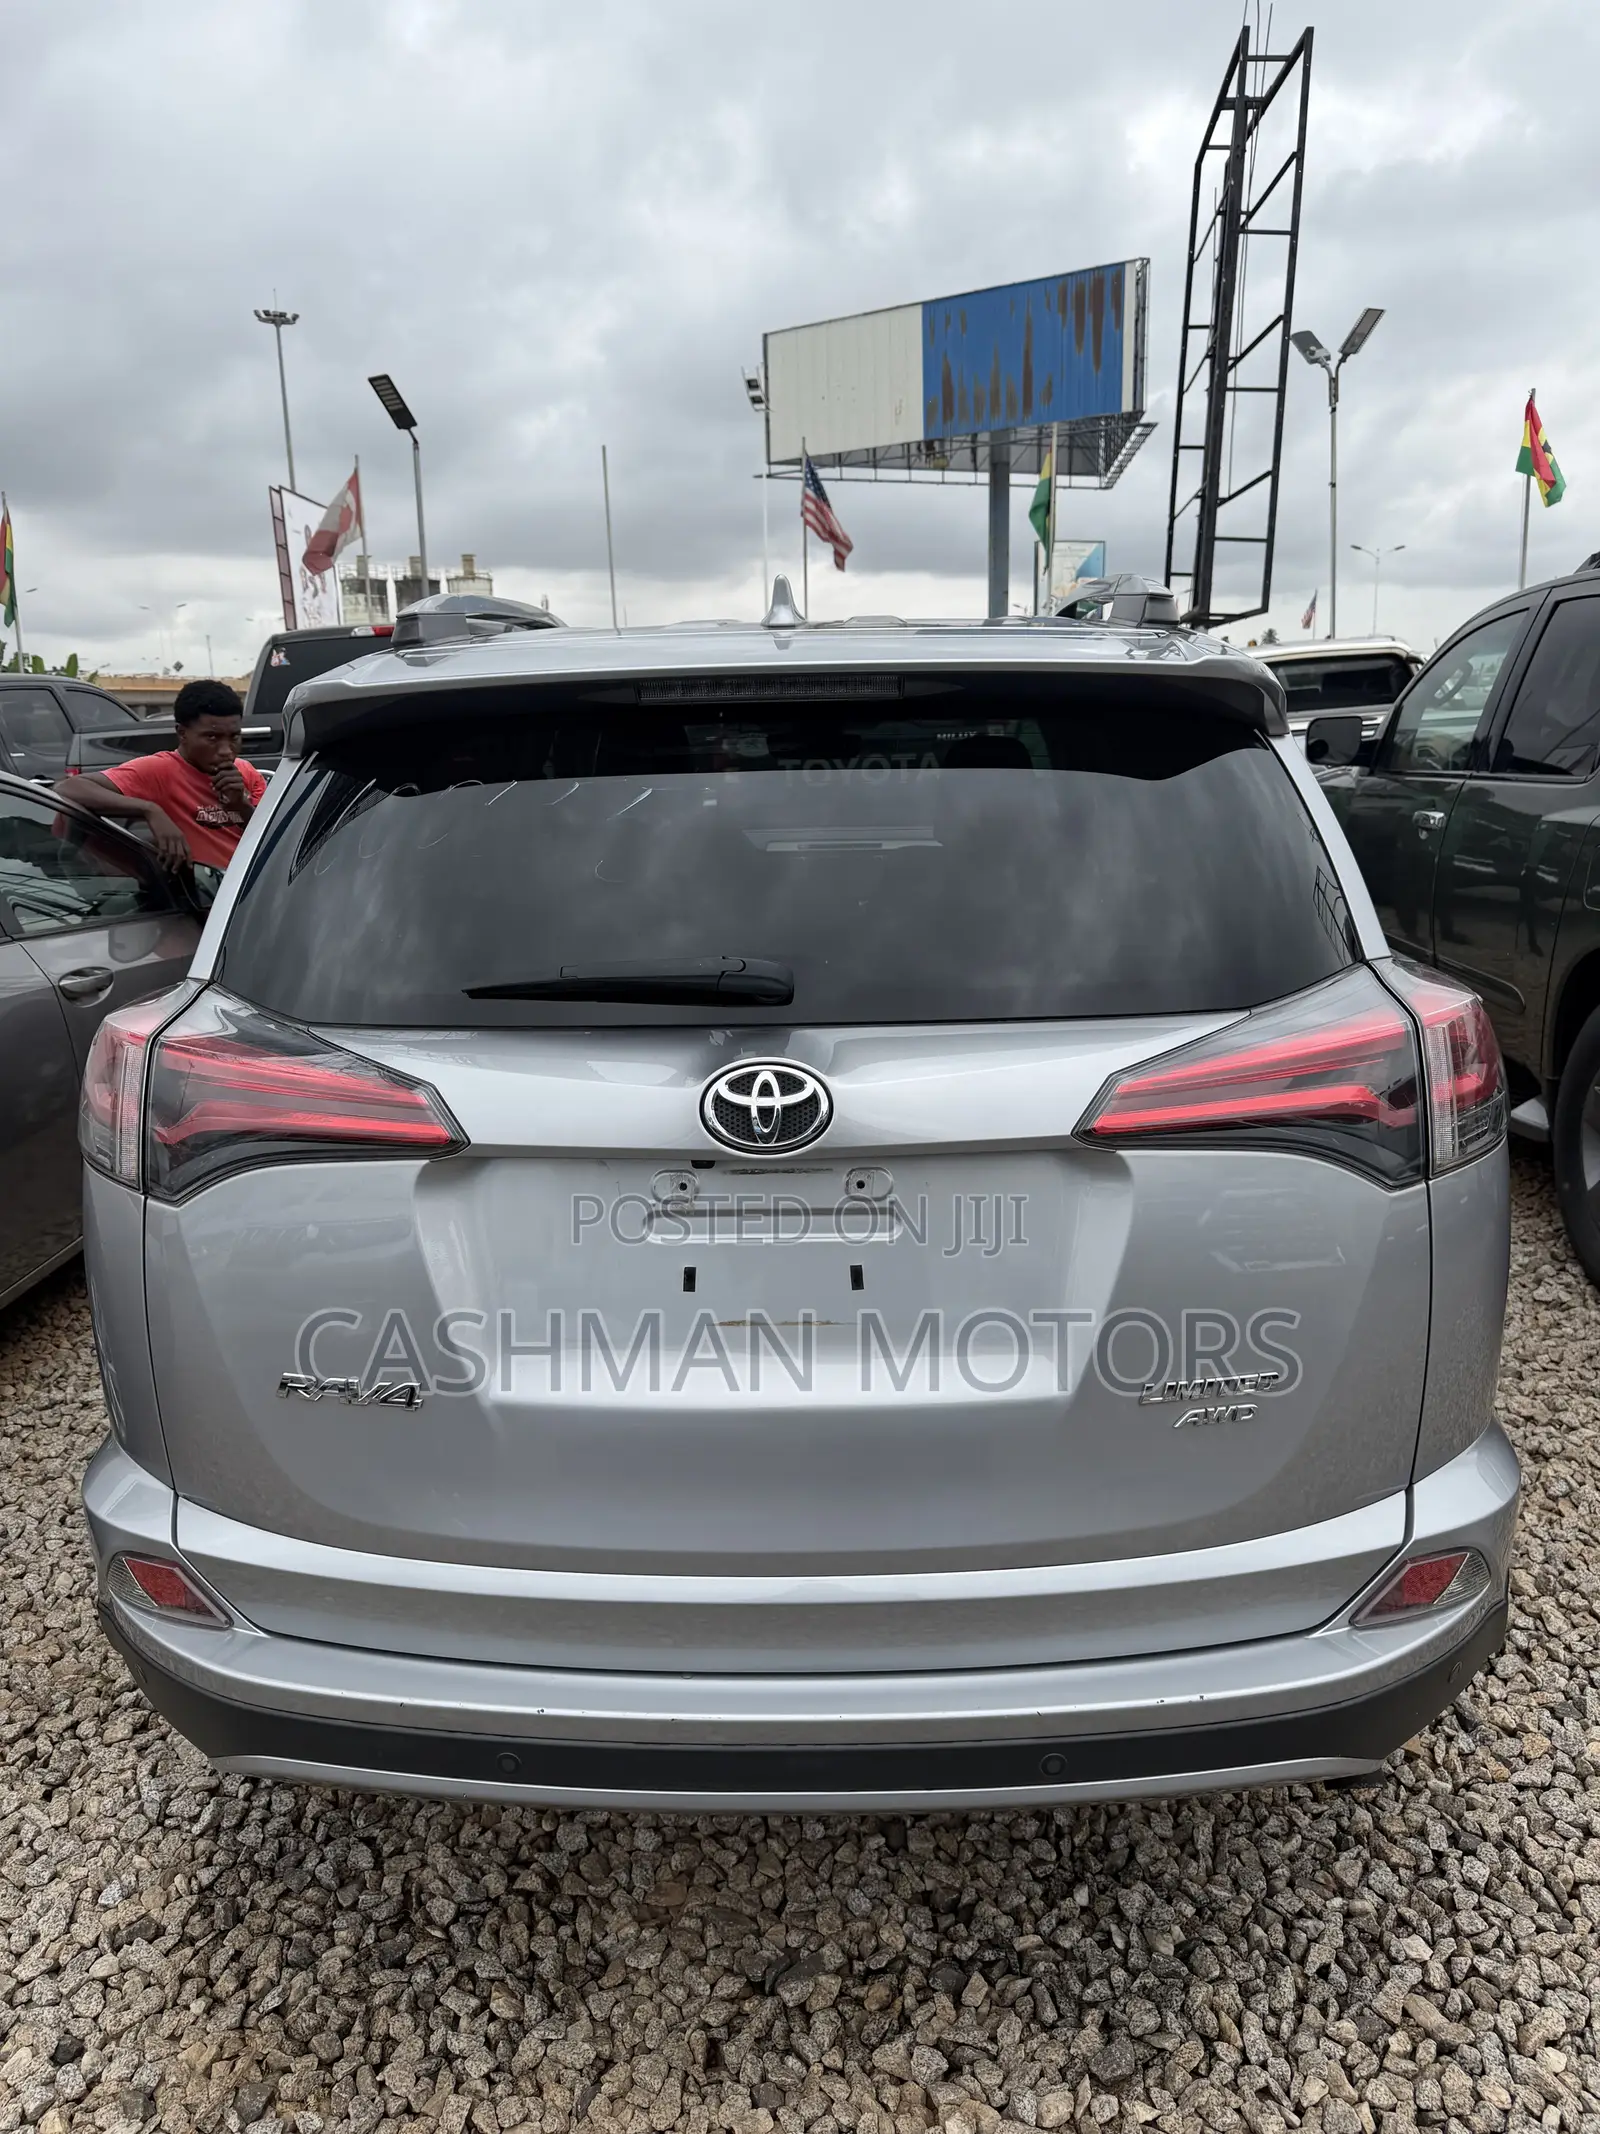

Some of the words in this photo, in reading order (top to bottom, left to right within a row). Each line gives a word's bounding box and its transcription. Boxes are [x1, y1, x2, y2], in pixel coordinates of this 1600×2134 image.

[777, 752, 941, 787] TOYOTA
[275, 1372, 424, 1411] RAV4
[1139, 1371, 1280, 1405] LIMITED
[1172, 1403, 1259, 1429] AWD
